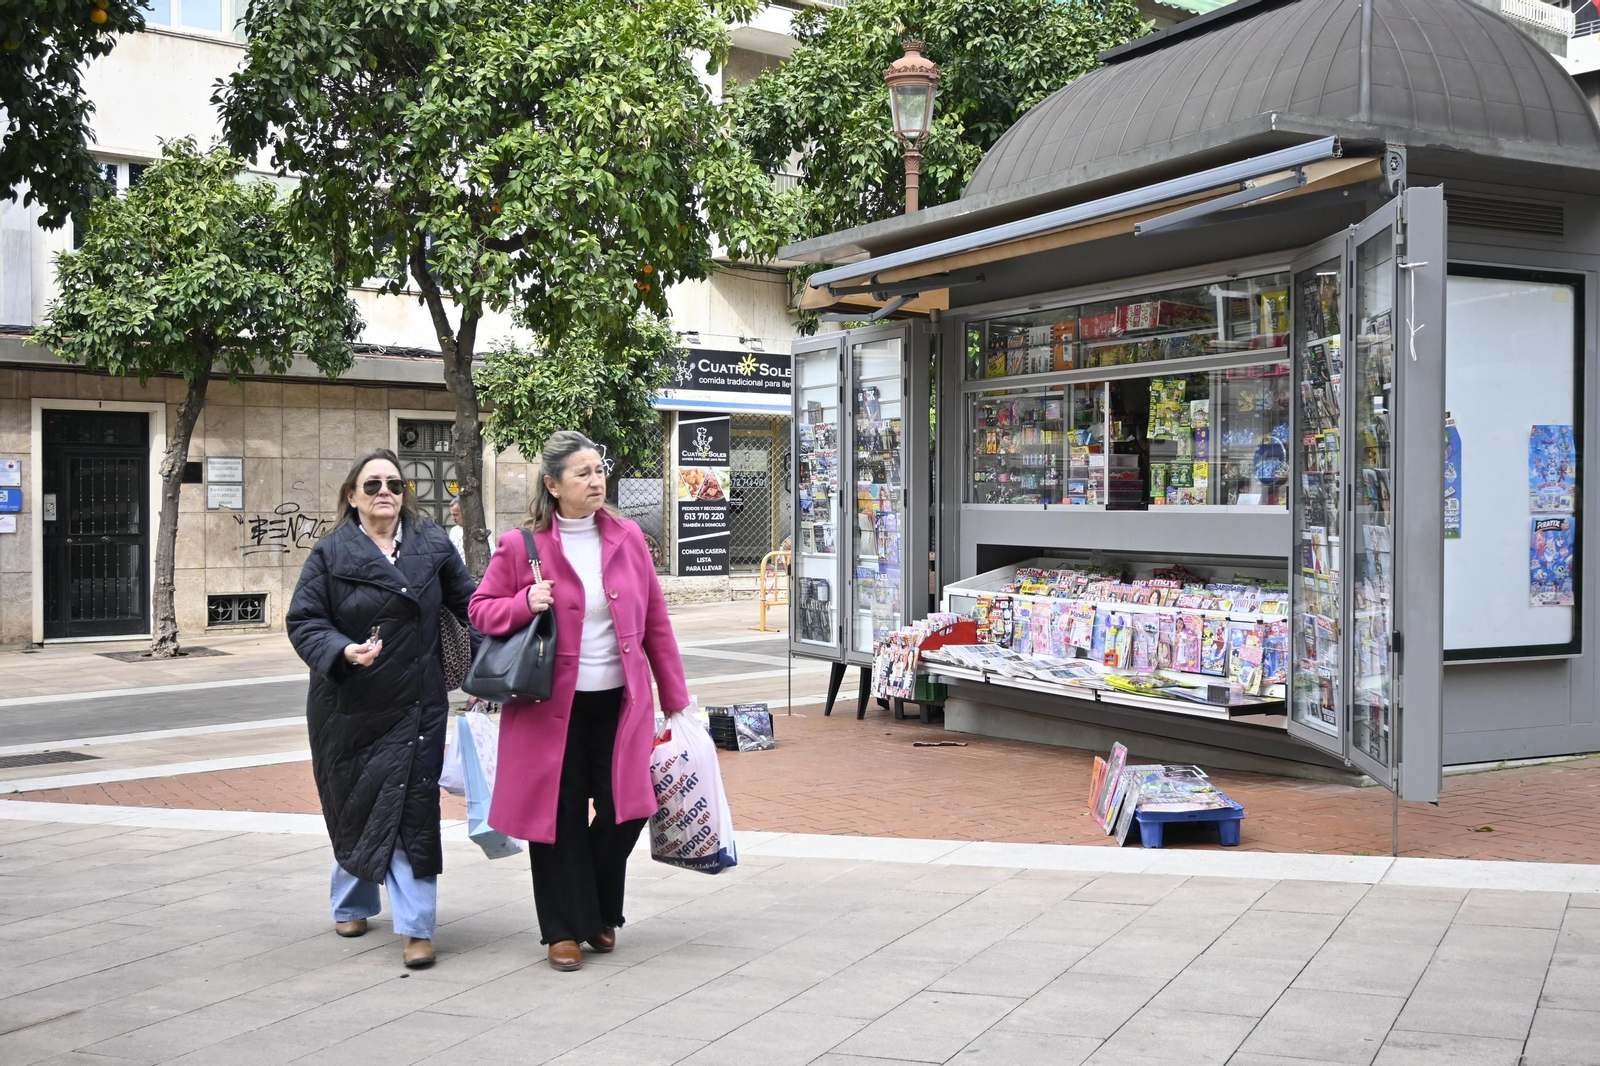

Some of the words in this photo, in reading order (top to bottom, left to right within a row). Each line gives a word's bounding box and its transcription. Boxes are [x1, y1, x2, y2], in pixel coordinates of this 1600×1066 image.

[699, 376, 726, 385] comida
[727, 377, 763, 387] tradicional
[684, 512, 697, 521] 613
[697, 512, 710, 520] 710
[711, 512, 725, 520] 220
[674, 825, 712, 860] MADRID
